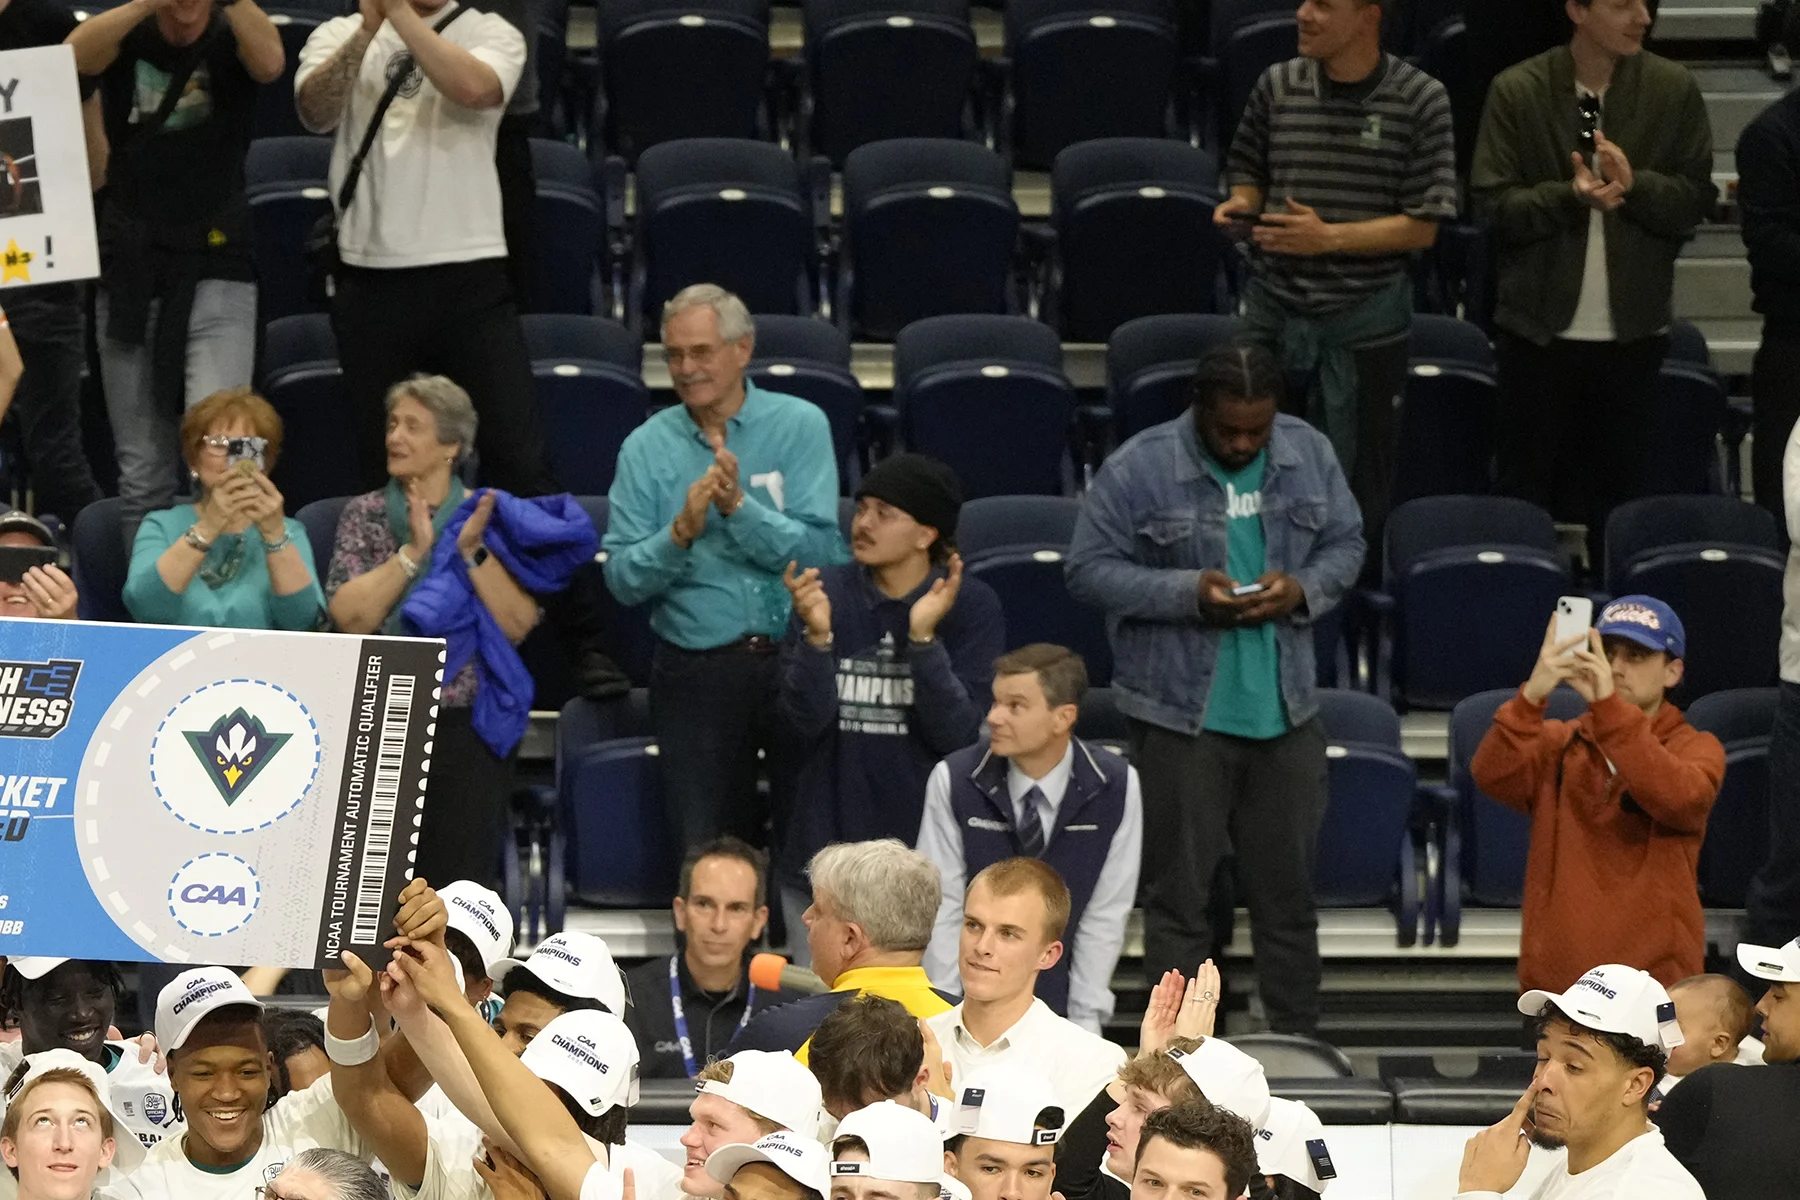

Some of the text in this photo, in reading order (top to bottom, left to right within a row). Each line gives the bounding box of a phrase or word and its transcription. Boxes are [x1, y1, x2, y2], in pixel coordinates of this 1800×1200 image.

[324, 655, 382, 959] NCAA TOURNAMENT AUTOMATIC QUALIFIER
[181, 884, 247, 906] CAA
[478, 899, 496, 915] CAA
[452, 896, 501, 942] CHAMPIONS
[550, 938, 567, 947] CAA
[186, 977, 206, 991] CAA
[1589, 970, 1605, 979] CAA
[173, 980, 232, 1015] CHAMPIONS
[577, 1035, 597, 1050] CAA
[551, 1034, 609, 1075] CHAMPIONS
